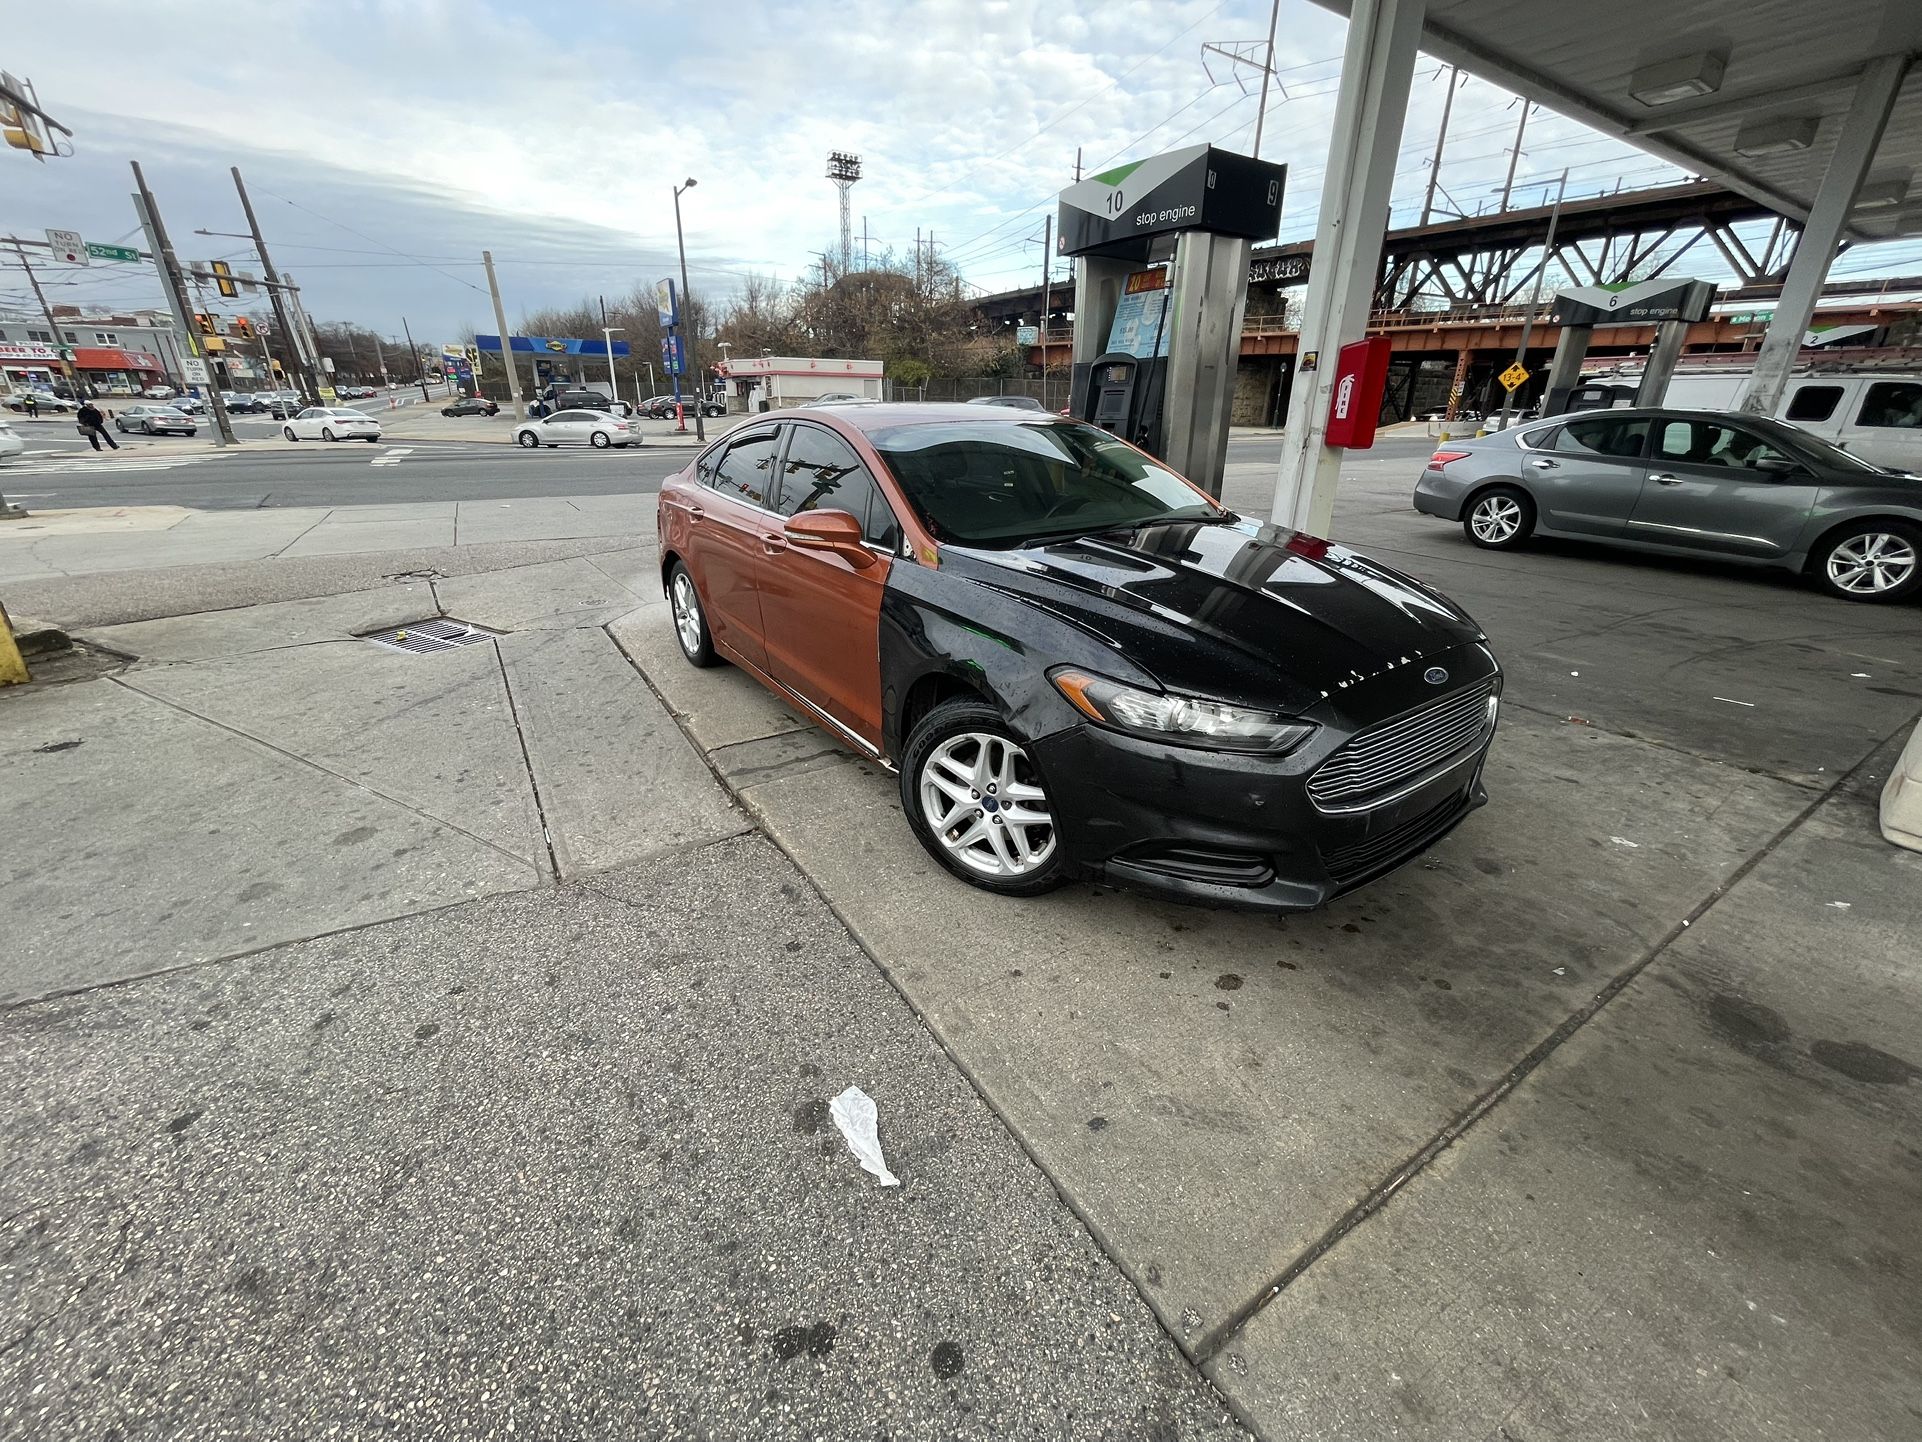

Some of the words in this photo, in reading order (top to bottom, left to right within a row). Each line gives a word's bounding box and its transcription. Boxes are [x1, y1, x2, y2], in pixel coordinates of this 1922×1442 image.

[1268, 181, 1278, 204] 9
[1106, 190, 1123, 214] 10
[1136, 212, 1157, 226] stop
[1160, 204, 1195, 222] engine
[54, 232, 73, 241] NO
[55, 240, 79, 248] TURN
[91, 246, 118, 257] 52nd
[124, 251, 137, 260] St
[1609, 295, 1618, 307] 6
[1630, 307, 1648, 316] stop
[1649, 307, 1679, 316] engine
[1810, 335, 1819, 345] 2
[1340, 385, 1349, 414] FIRE
